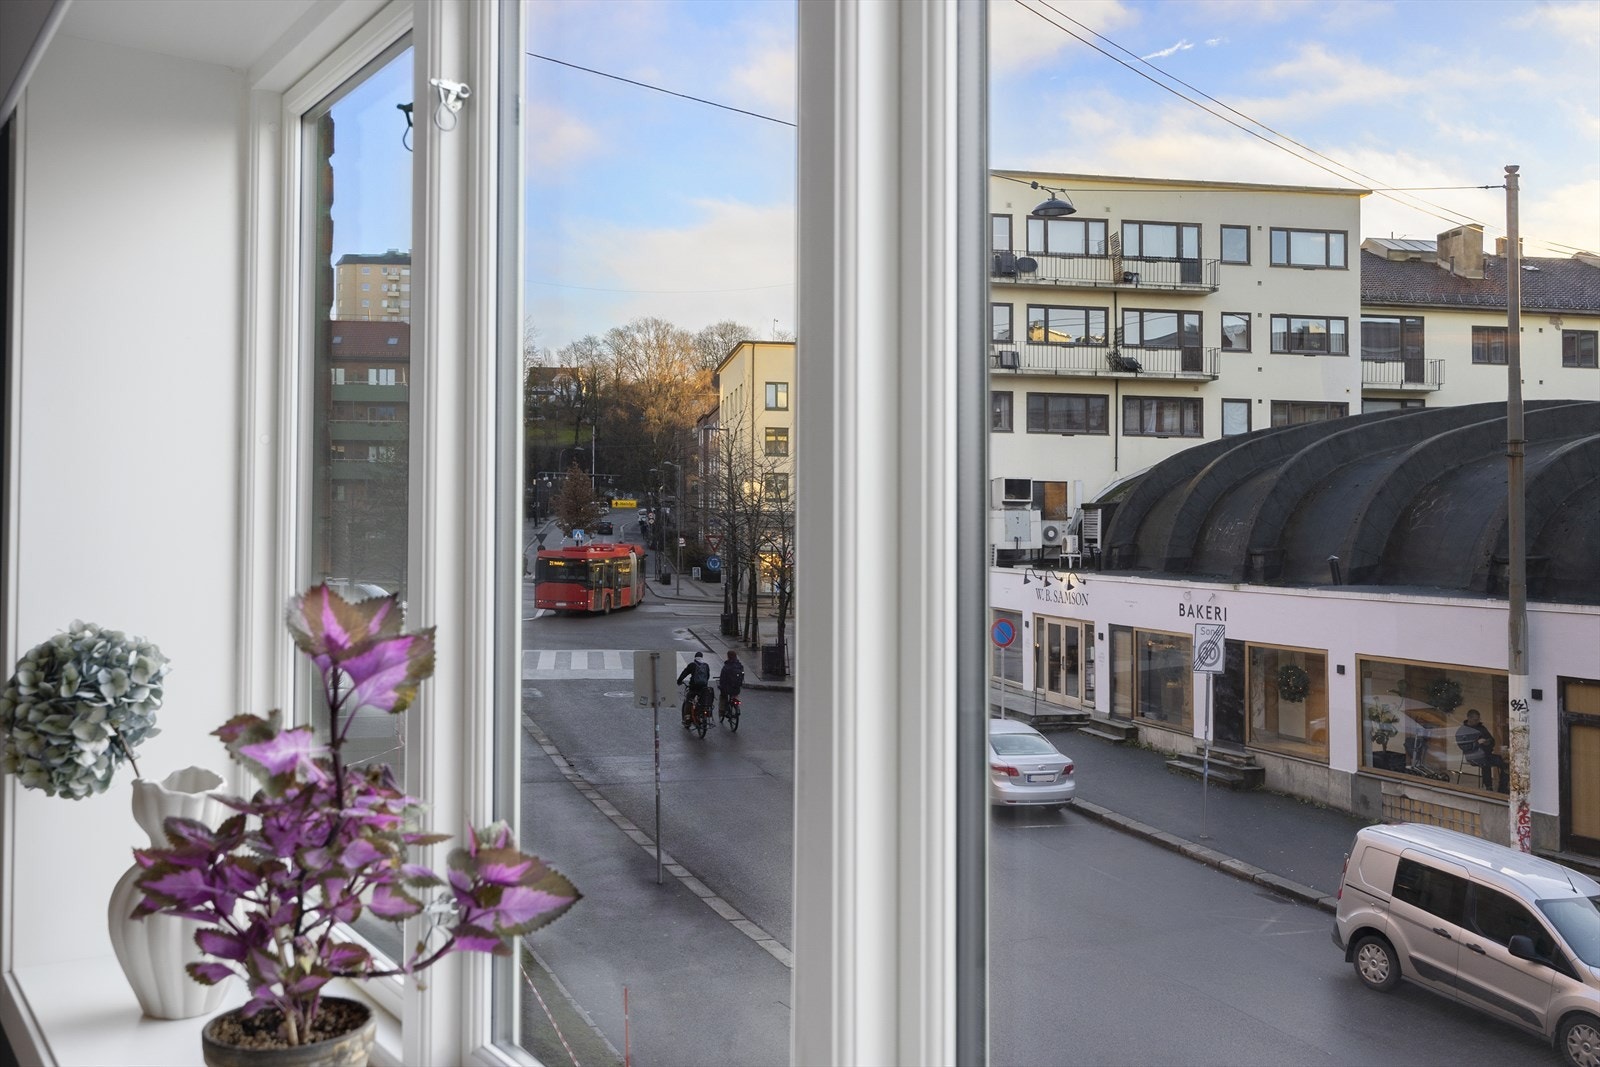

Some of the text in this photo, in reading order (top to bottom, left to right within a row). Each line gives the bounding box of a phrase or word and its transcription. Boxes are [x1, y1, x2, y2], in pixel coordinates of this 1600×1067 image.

[1035, 588, 1089, 606] W. B. SAMSON
[1179, 602, 1227, 621] BAKERI
